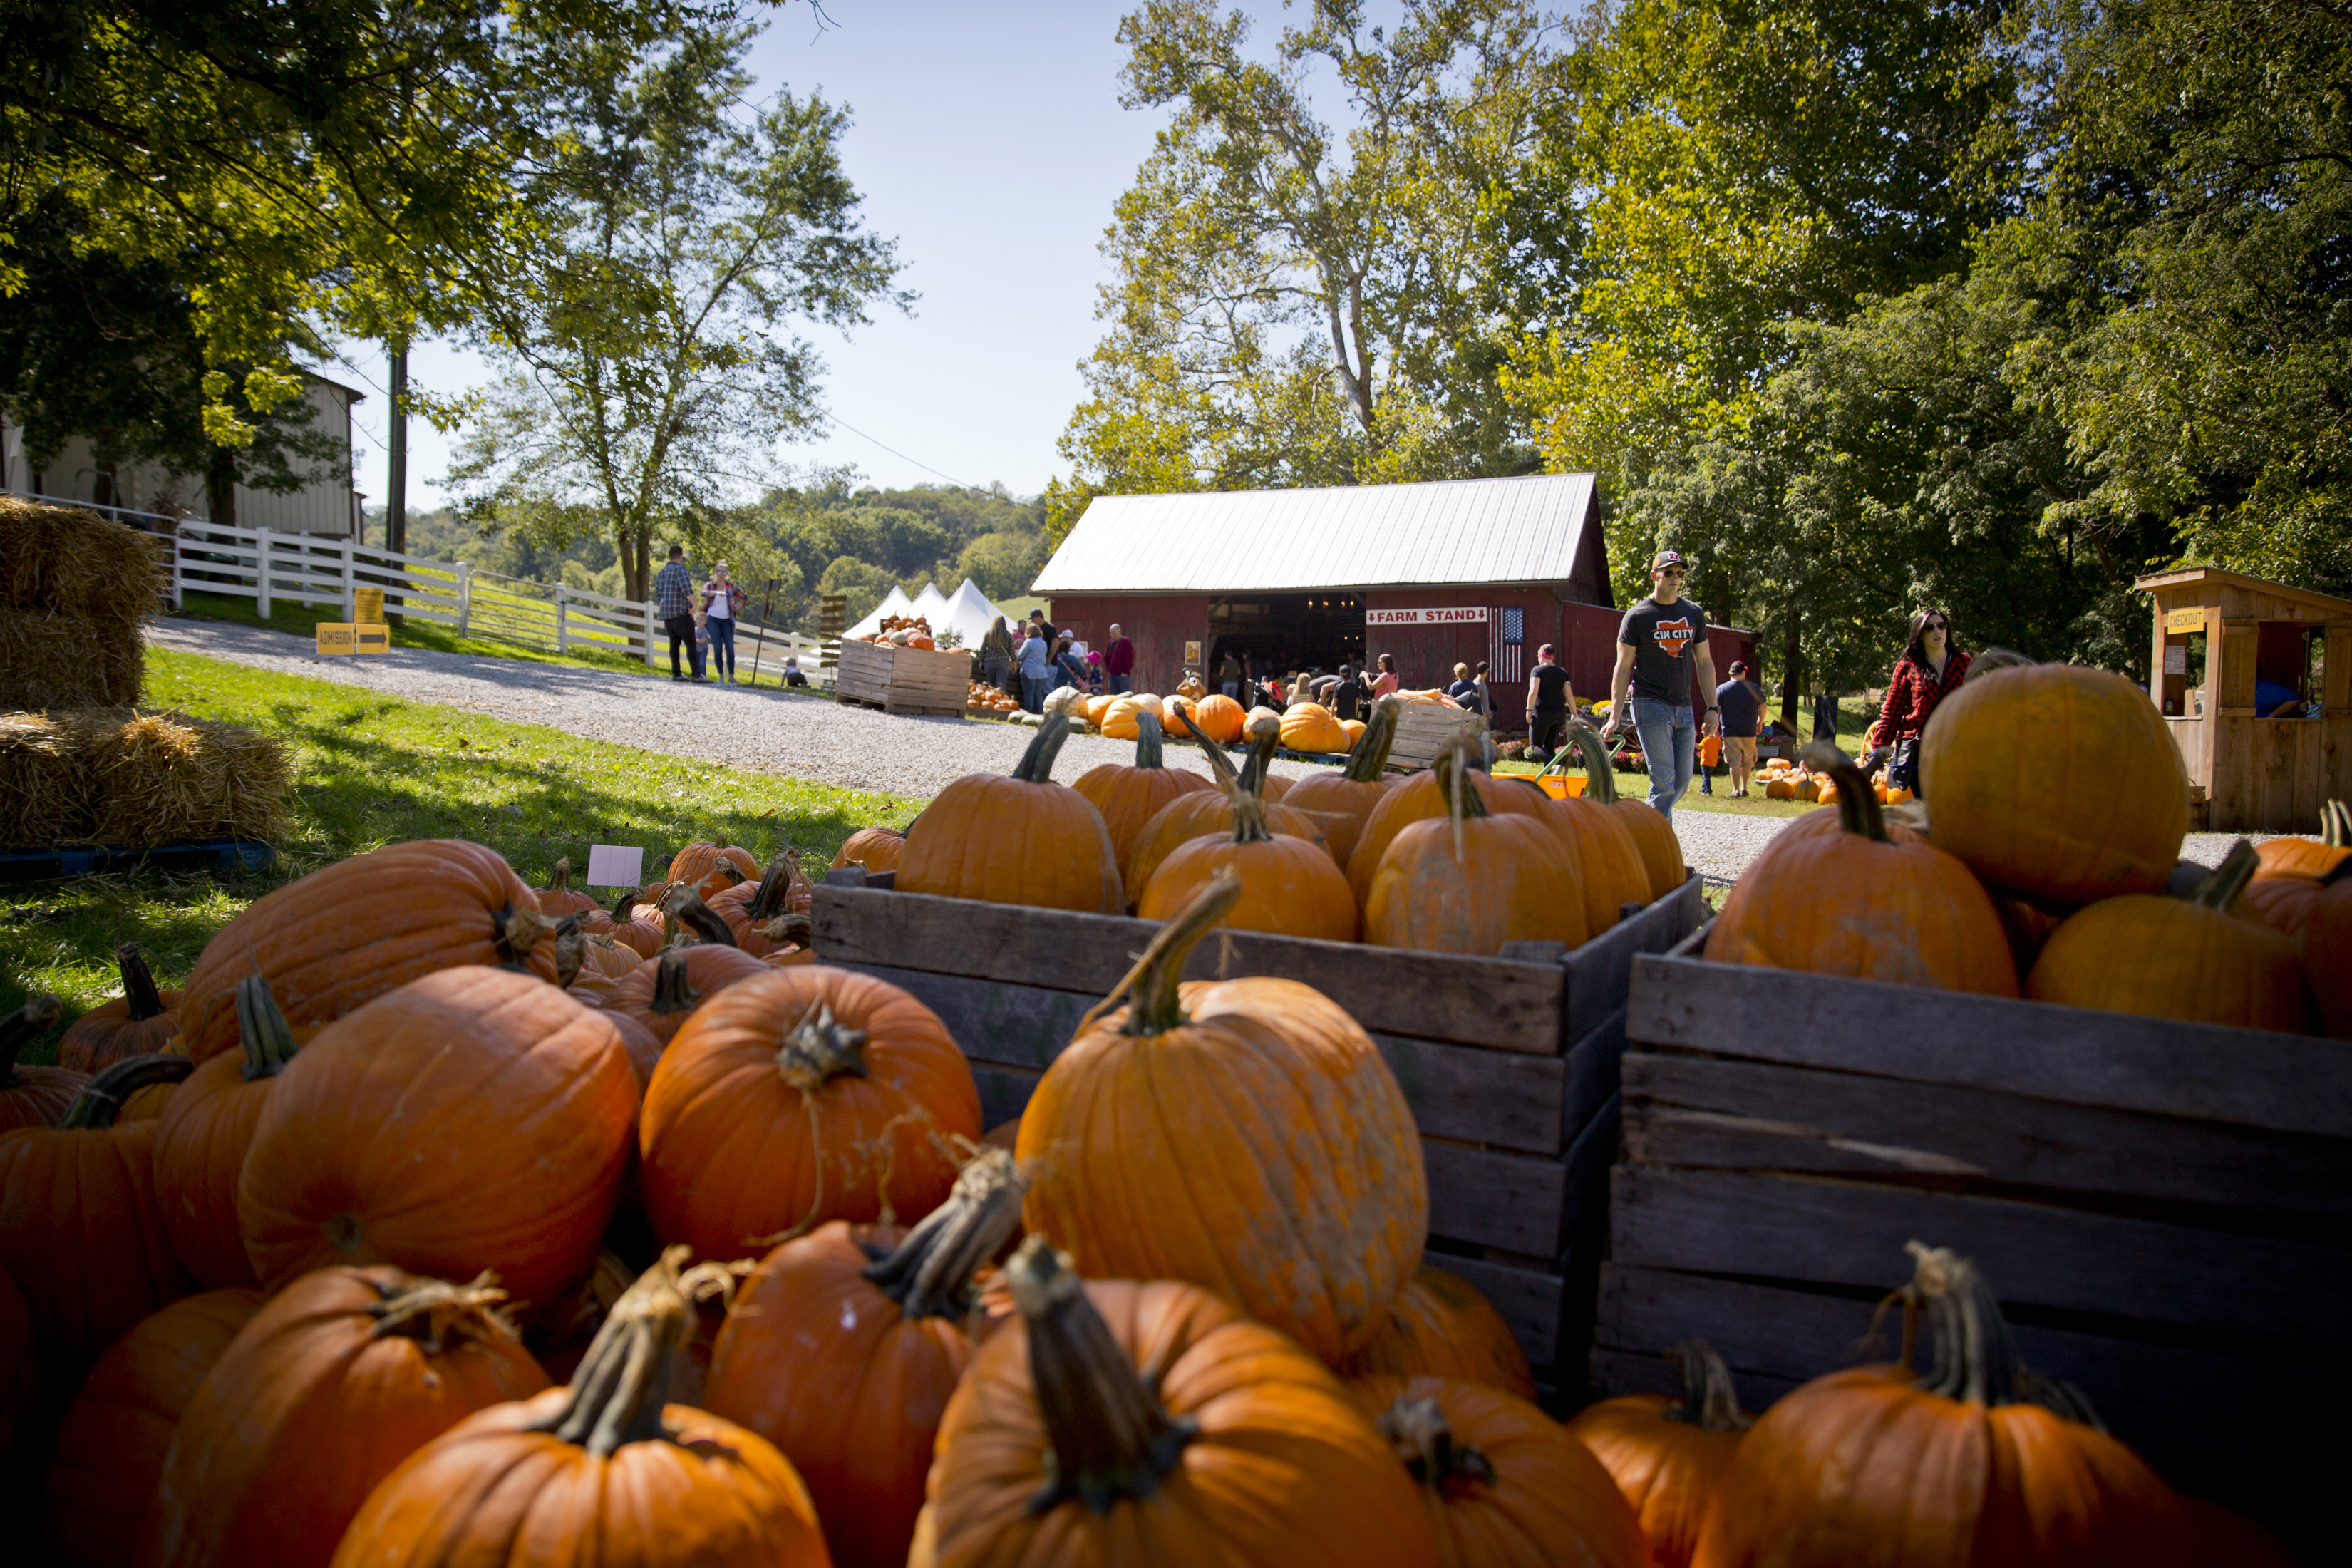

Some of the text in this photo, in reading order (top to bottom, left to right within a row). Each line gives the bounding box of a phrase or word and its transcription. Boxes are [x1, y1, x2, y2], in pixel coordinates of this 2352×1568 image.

[1377, 610, 1476, 622] FARM STAND
[2170, 612, 2202, 627] CHECKOUT
[319, 631, 353, 645] ADMISSION
[1653, 629, 1693, 640] CIN CITY
